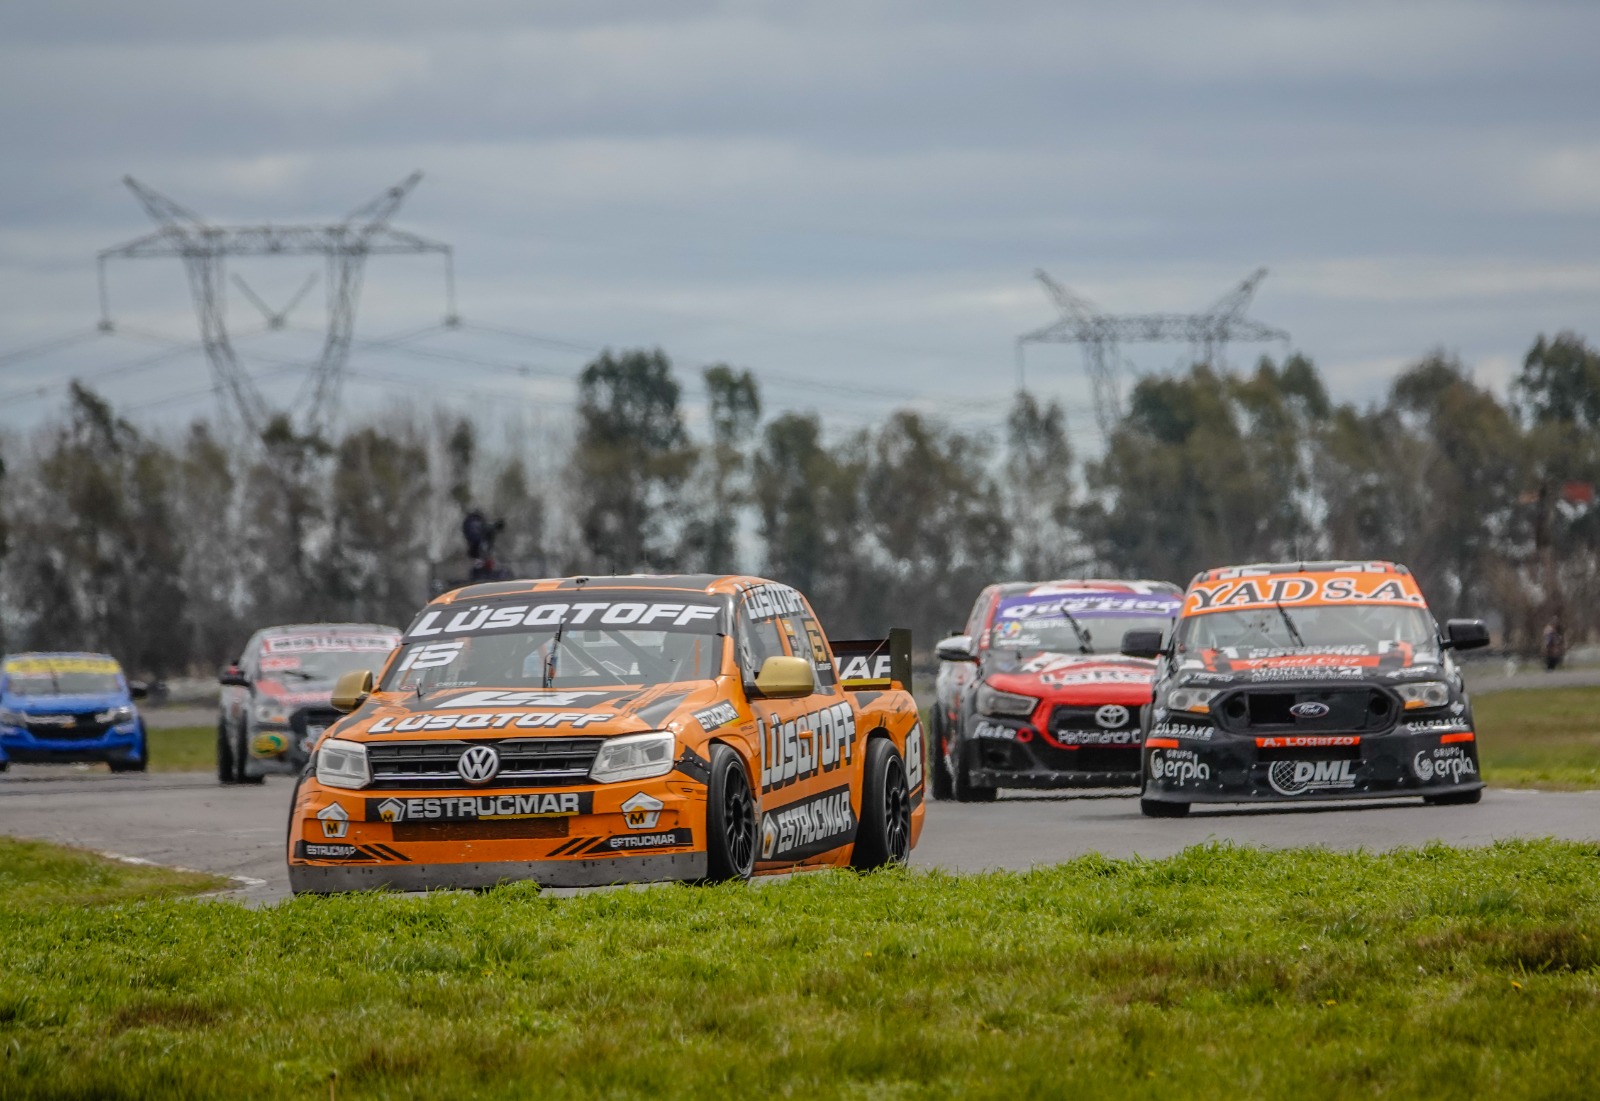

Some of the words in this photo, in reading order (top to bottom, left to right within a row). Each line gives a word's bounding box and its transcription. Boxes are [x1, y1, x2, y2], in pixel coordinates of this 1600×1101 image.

[1190, 576, 1318, 612] YAD
[409, 602, 721, 637] LÜSQTOFF
[368, 712, 615, 734] LÜSQTOFF
[1166, 748, 1193, 760] GRUPO
[1433, 746, 1460, 758] GRUPO
[1294, 759, 1357, 783] DML
[407, 792, 579, 819] ESTRUCMAR
[327, 822, 339, 835] M
[629, 813, 645, 825] M
[777, 790, 852, 853] ESTRUCMAR
[610, 833, 676, 848] ESTRUCMAR
